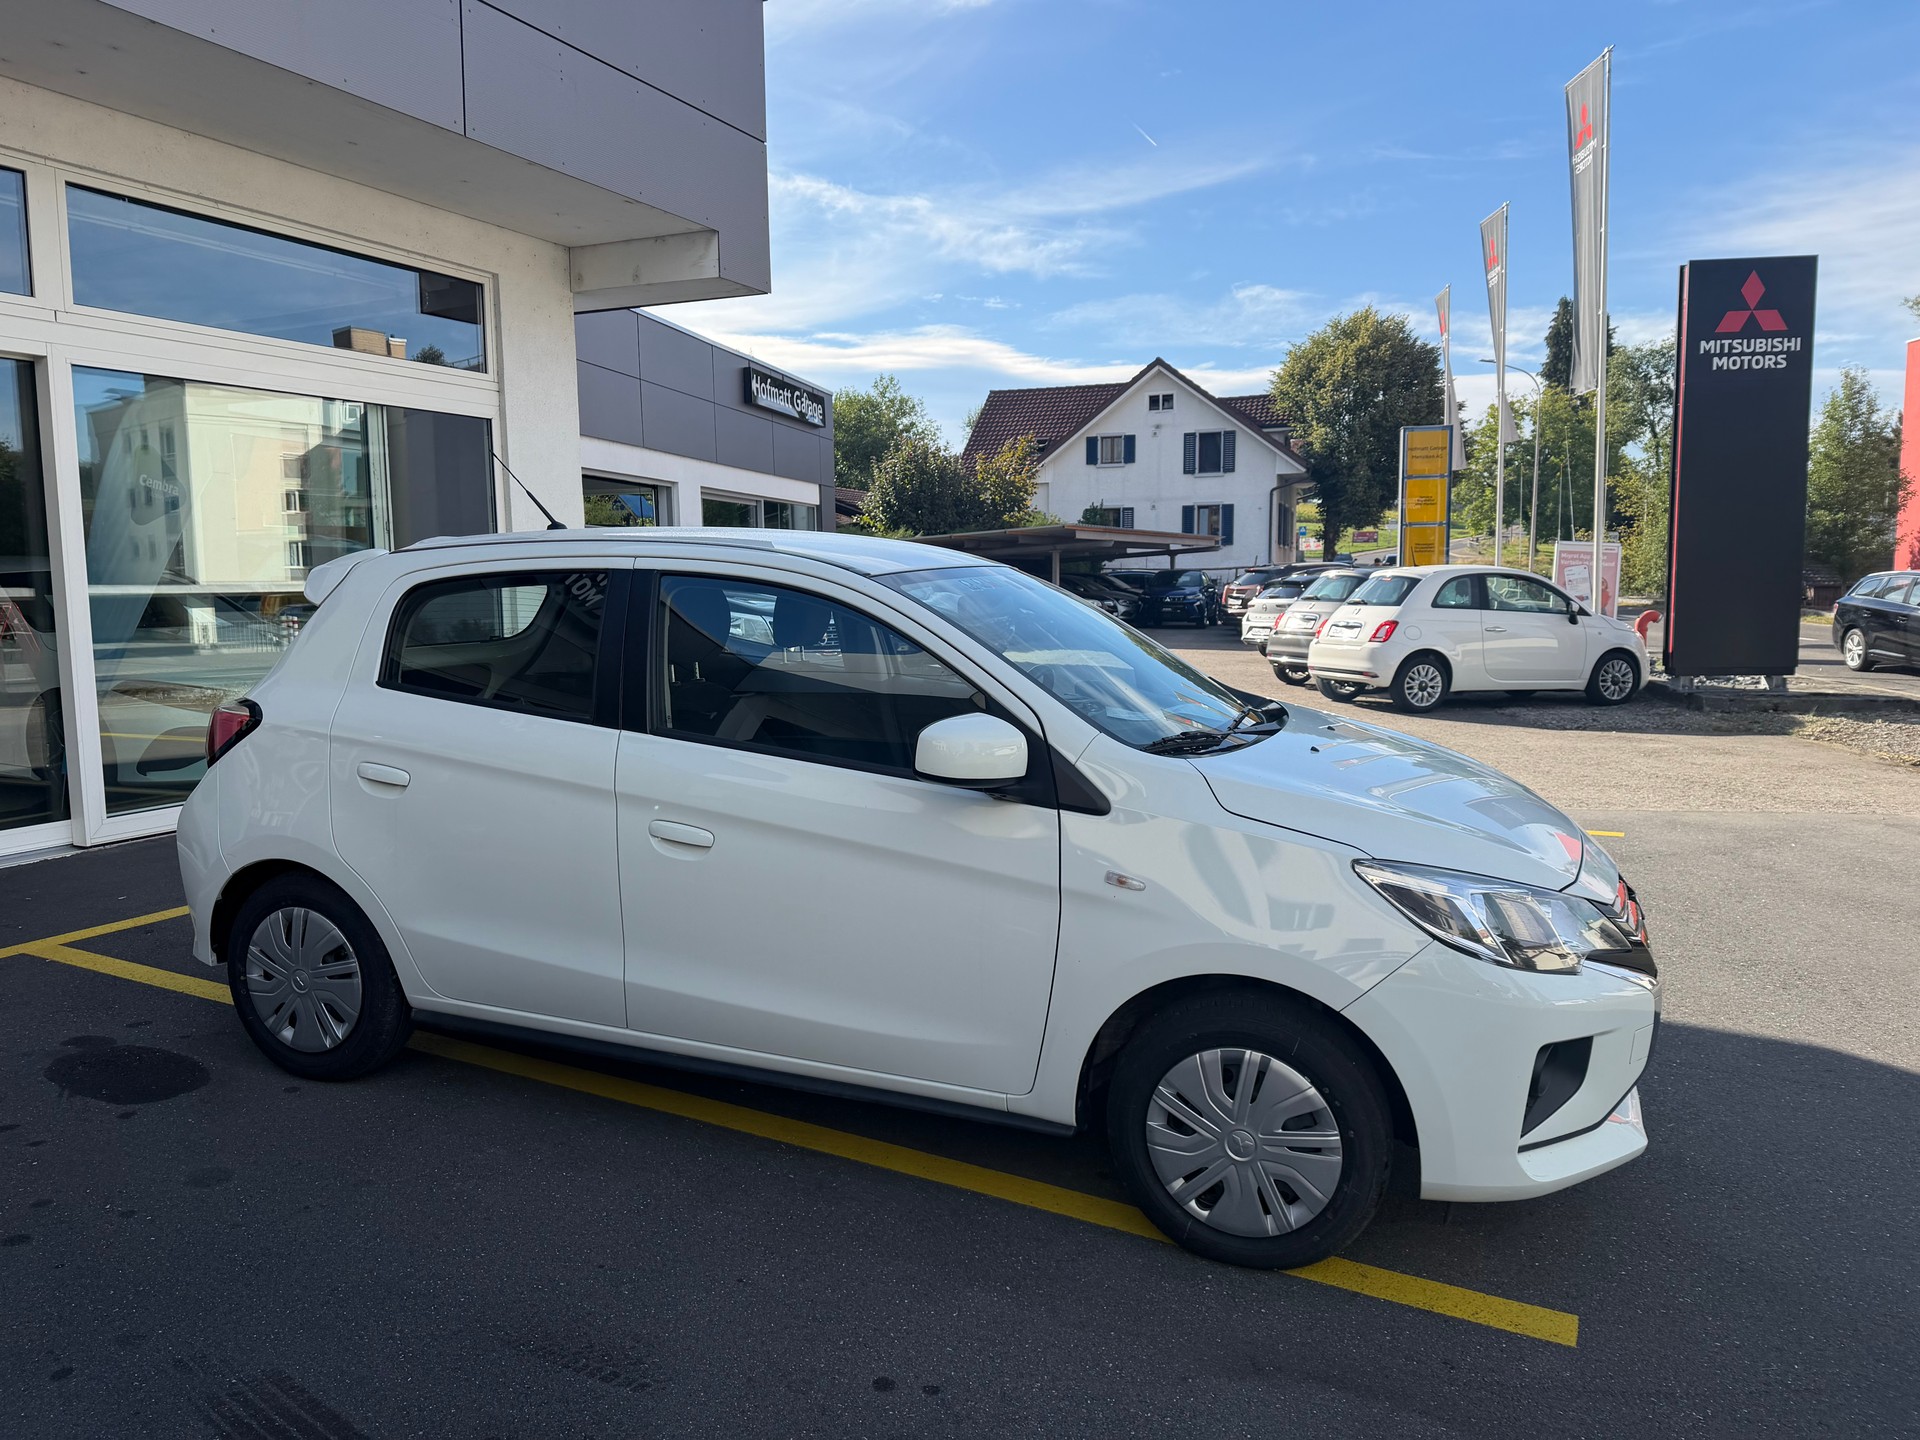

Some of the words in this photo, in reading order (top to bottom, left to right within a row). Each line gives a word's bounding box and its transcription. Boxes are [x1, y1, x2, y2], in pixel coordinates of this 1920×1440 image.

[1699, 337, 1802, 354] MITSUBISHI
[1712, 354, 1788, 371] MOTORS
[751, 374, 793, 409] Hofmatt
[793, 390, 823, 422] Garage
[139, 474, 180, 496] Cembra
